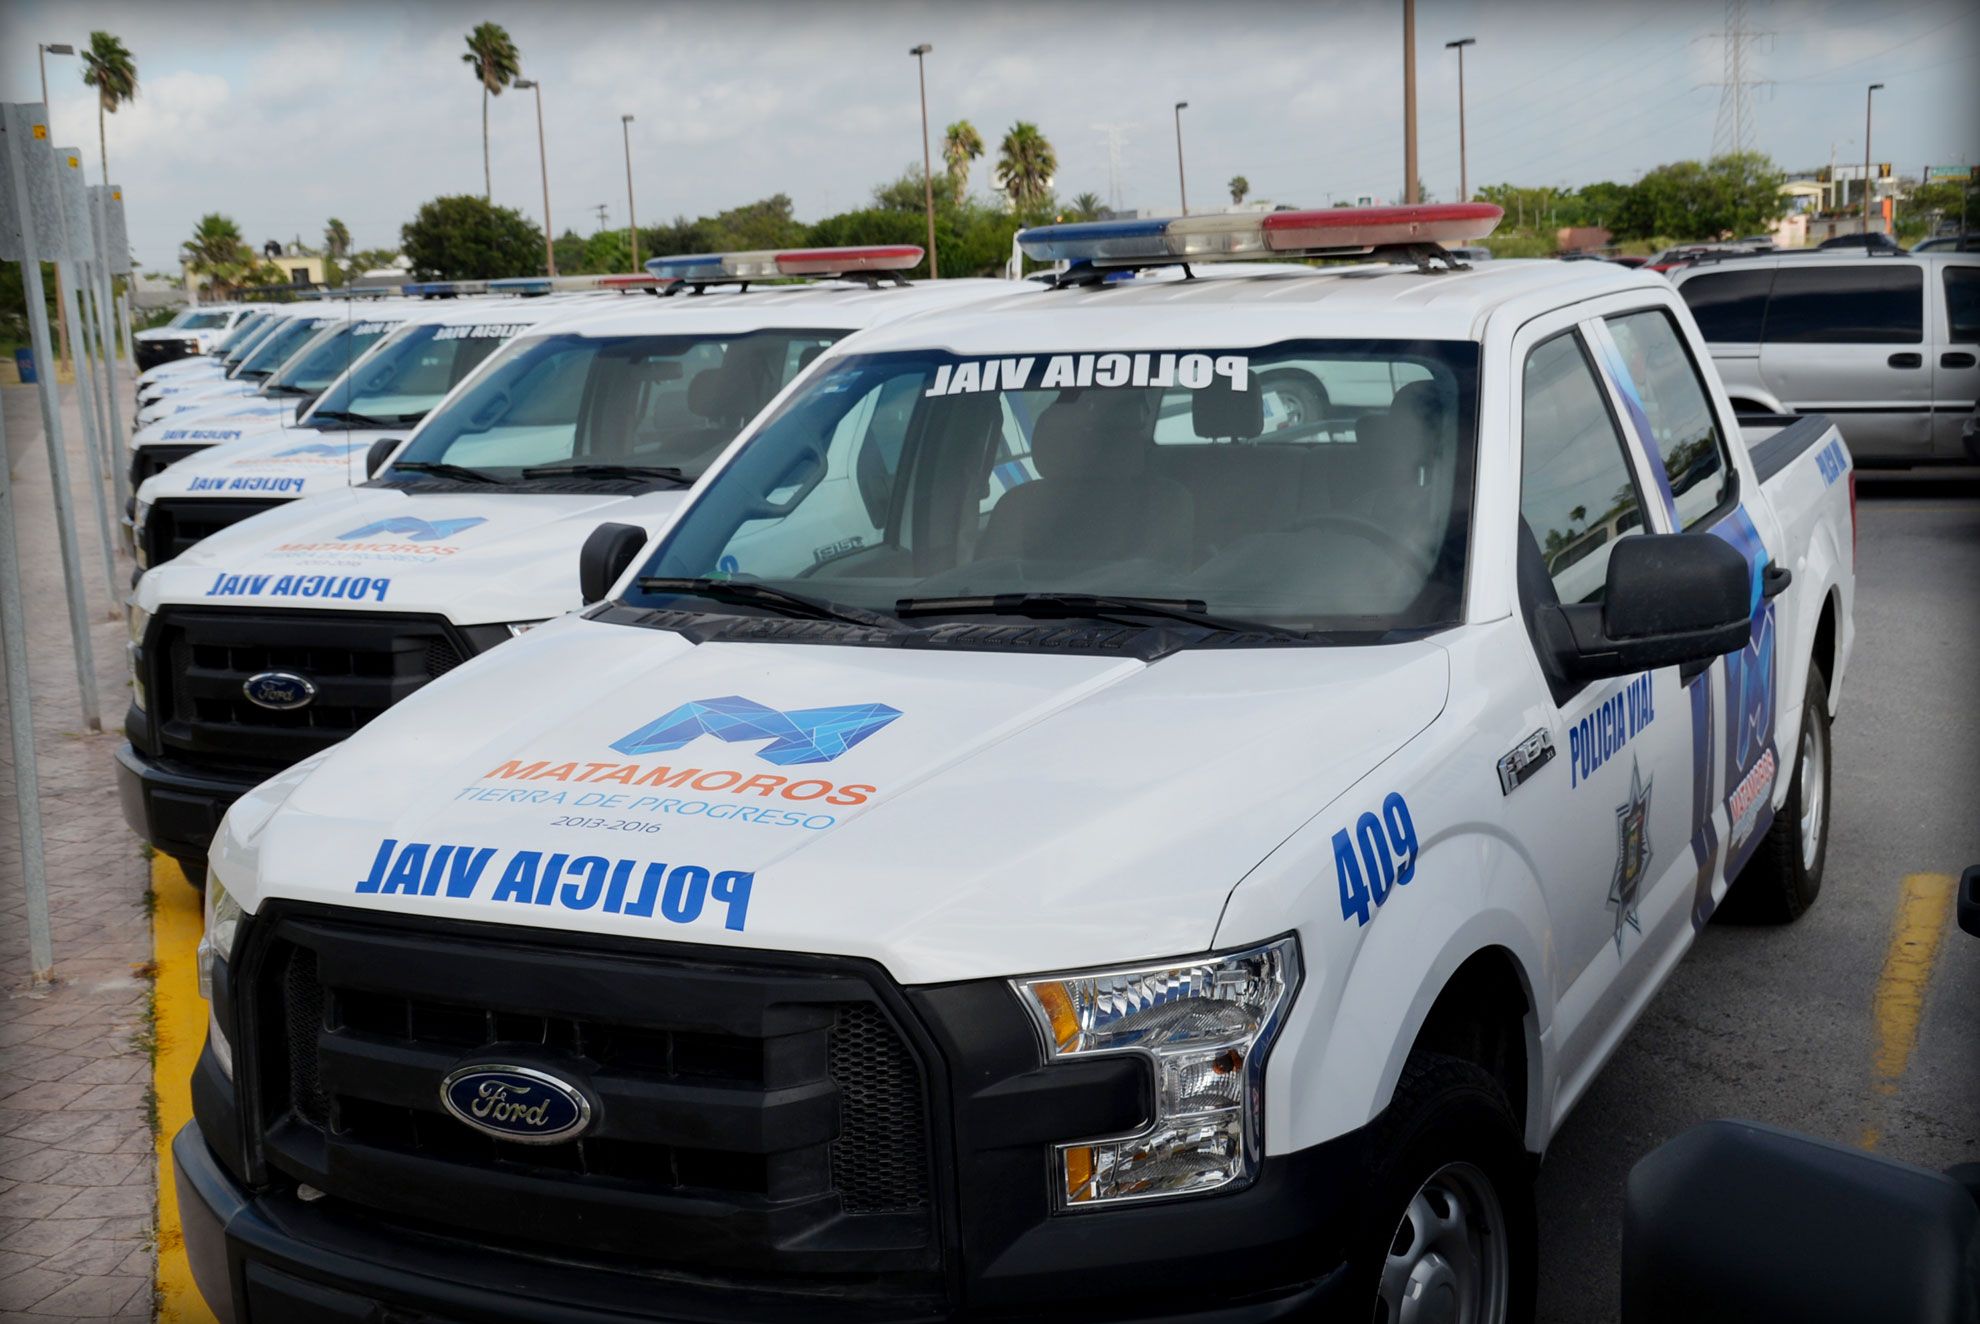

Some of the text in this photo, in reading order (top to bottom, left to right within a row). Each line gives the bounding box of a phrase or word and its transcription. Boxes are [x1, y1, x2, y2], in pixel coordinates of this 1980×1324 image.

[257, 679, 296, 701] Ford
[1568, 670, 1655, 790] POLICIA VIAL
[483, 759, 878, 806] MATAMOROS
[456, 786, 836, 832] TIERRA DE PROGRESO
[550, 815, 661, 835] 2013-2016
[1331, 791, 1420, 928] 409
[471, 1079, 550, 1126] Ford
